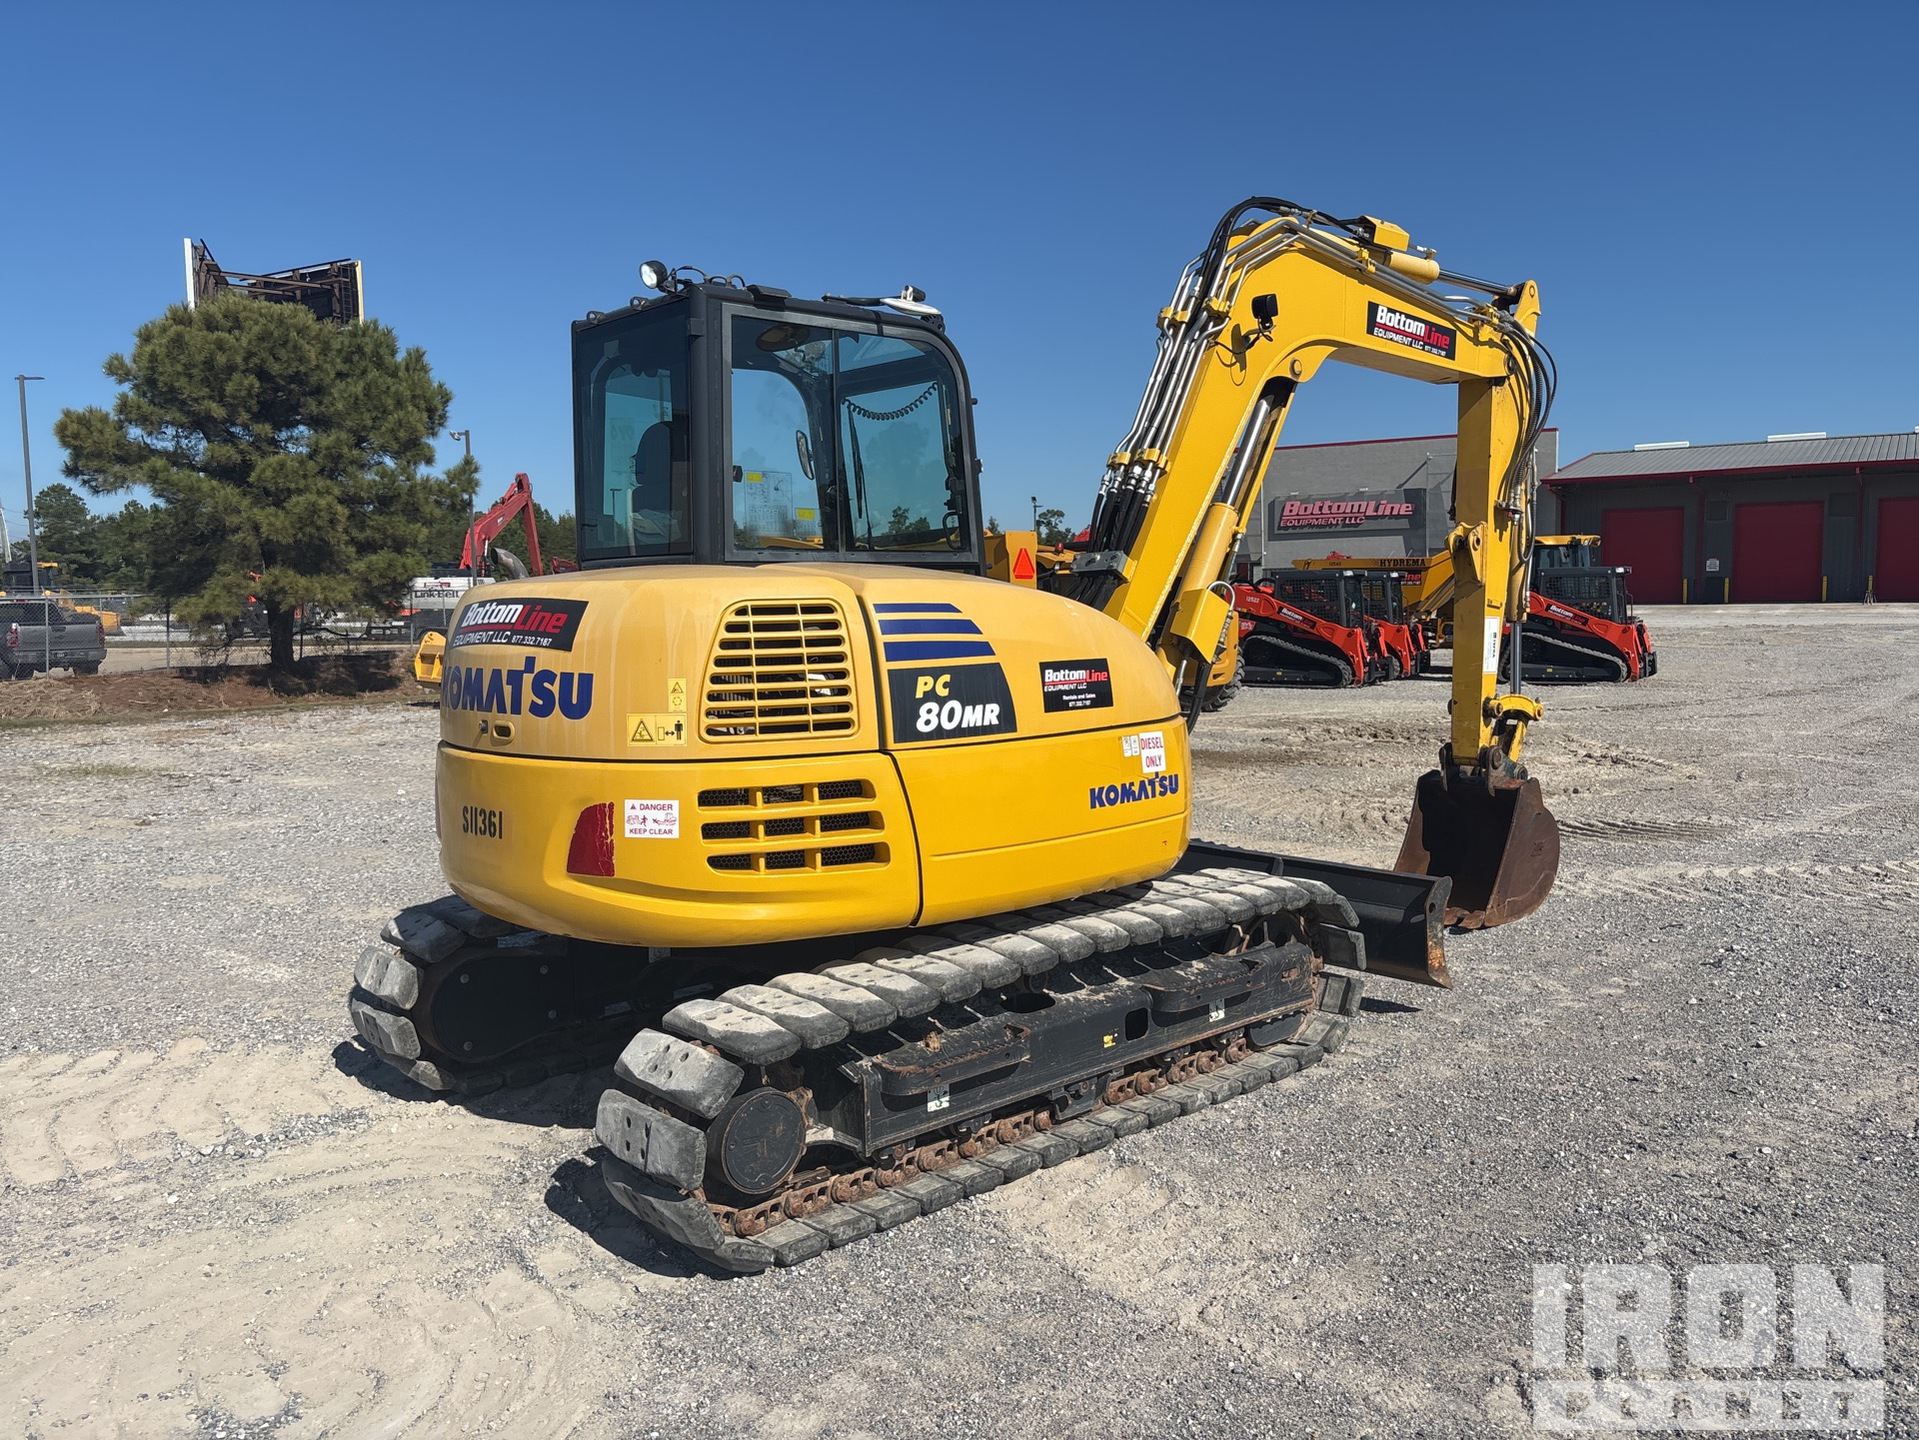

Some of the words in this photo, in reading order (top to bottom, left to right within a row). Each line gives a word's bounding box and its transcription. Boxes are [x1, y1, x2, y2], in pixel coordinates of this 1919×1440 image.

[1376, 305, 1450, 349] BottomLine
[1373, 327, 1412, 346] EQUIPMENT
[1411, 339, 1424, 349] LLC
[1282, 500, 1415, 517] BottomLine
[1280, 517, 1342, 527] EQUIPMENT
[1345, 516, 1366, 524] LLC
[1380, 558, 1426, 567] HYDREMA
[461, 602, 568, 634] BottomLine
[453, 632, 494, 647] EQUIPMENT
[492, 631, 511, 644] LLC
[1044, 669, 1108, 682] BottomLine
[444, 656, 594, 720] KOMATSU
[915, 674, 951, 699] PC
[1044, 683, 1077, 692] EQUIPMENT
[916, 700, 1000, 733] 80MR
[1141, 737, 1164, 750] DIESEL
[1145, 755, 1162, 768] ONLY
[1090, 771, 1179, 810] KOMATSU
[639, 803, 673, 811] DANGER
